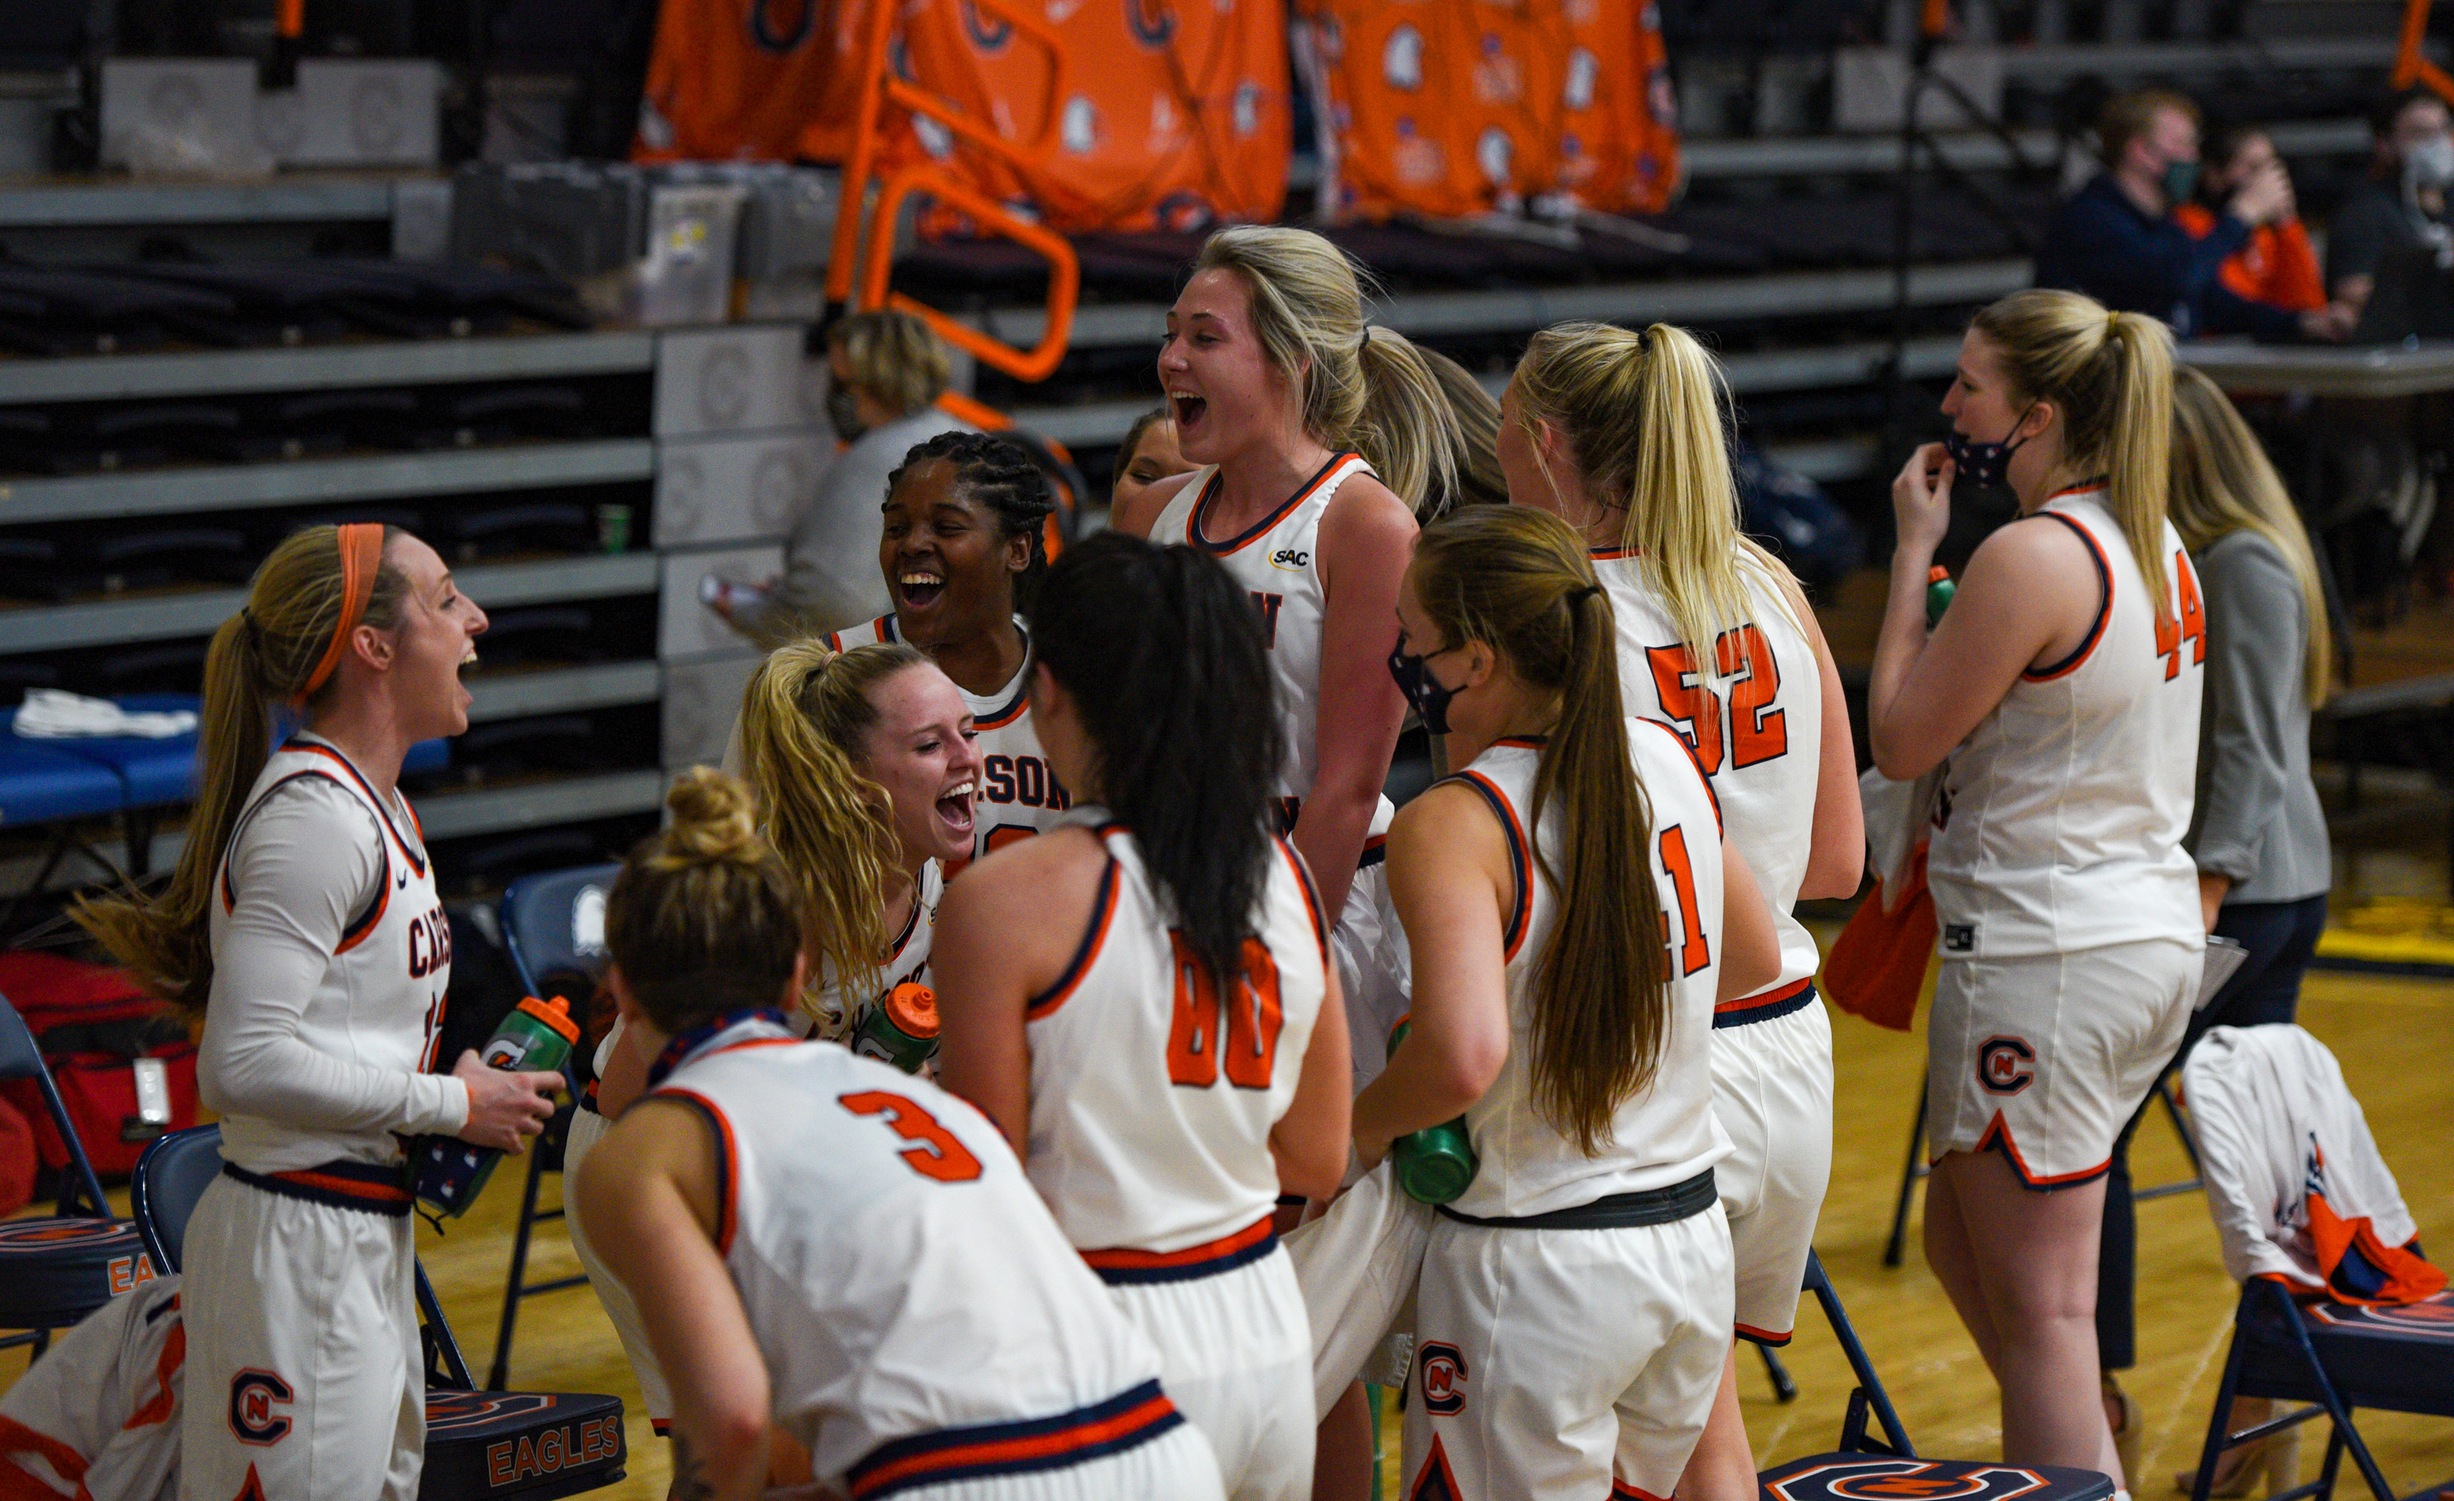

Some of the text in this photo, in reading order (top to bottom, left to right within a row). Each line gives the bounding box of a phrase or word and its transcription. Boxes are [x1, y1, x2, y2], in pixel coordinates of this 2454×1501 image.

[1274, 549, 1309, 567] SAC
[2154, 548, 2207, 683] 44
[1644, 622, 1788, 778] 52
[977, 754, 1071, 811] SON
[837, 1088, 984, 1185] 3
[486, 1415, 620, 1487] EAGLES
